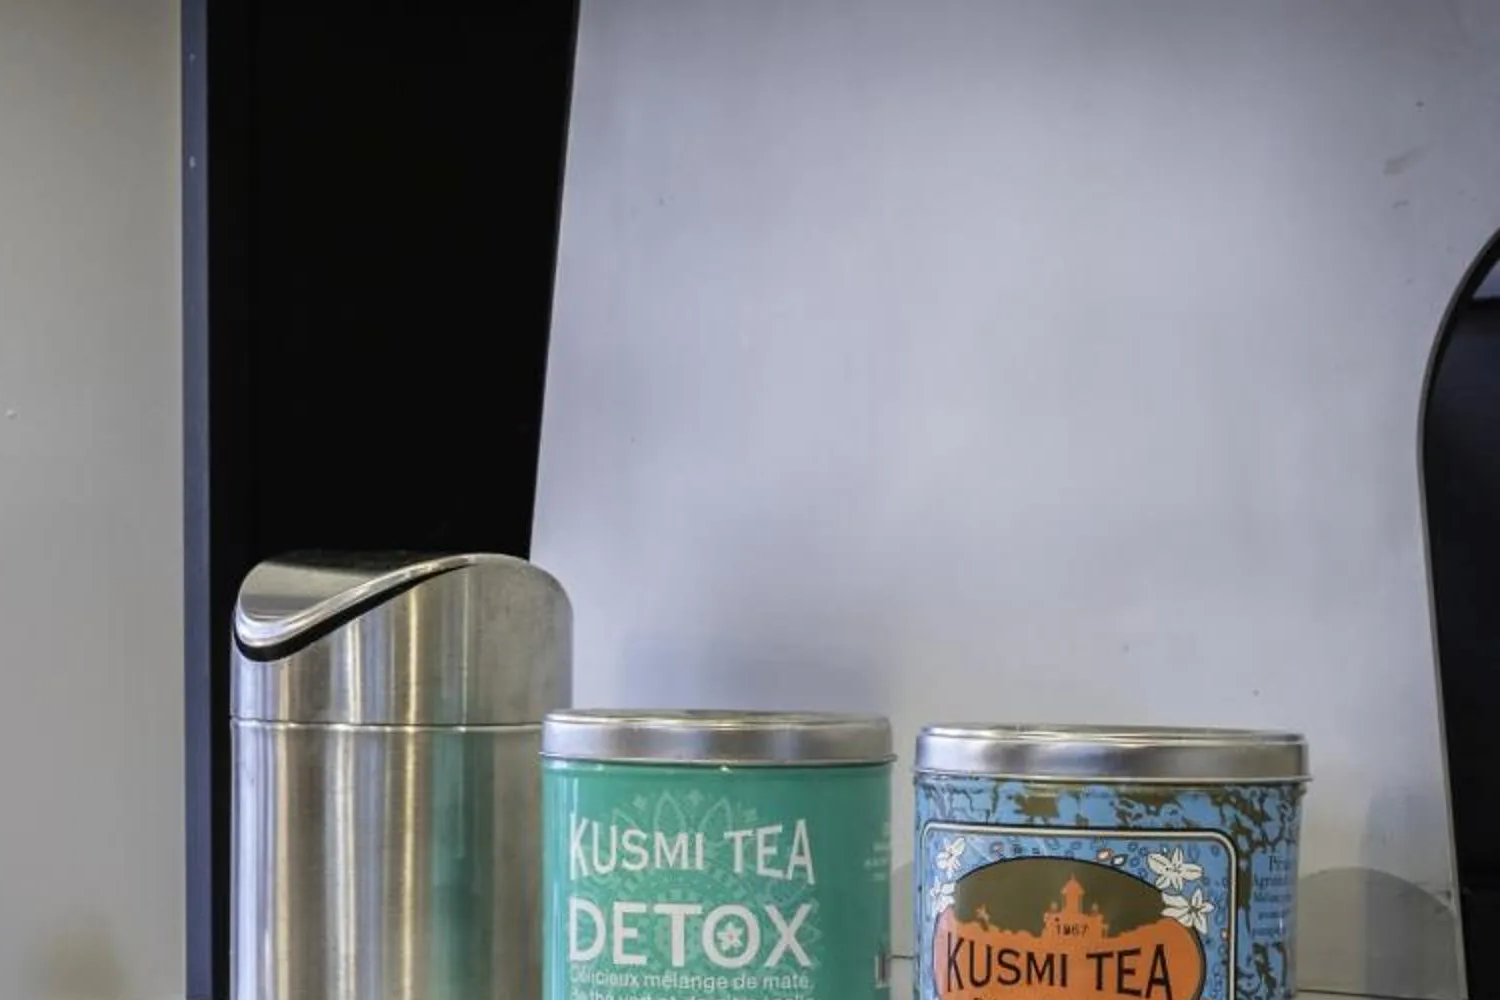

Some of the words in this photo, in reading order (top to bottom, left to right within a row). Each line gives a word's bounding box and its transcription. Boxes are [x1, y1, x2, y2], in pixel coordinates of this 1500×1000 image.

[569, 814, 705, 881] KUSMI
[724, 818, 815, 885] TEA
[568, 896, 812, 968] DETOX
[946, 932, 1068, 992] KUSMI
[732, 973, 757, 989] de
